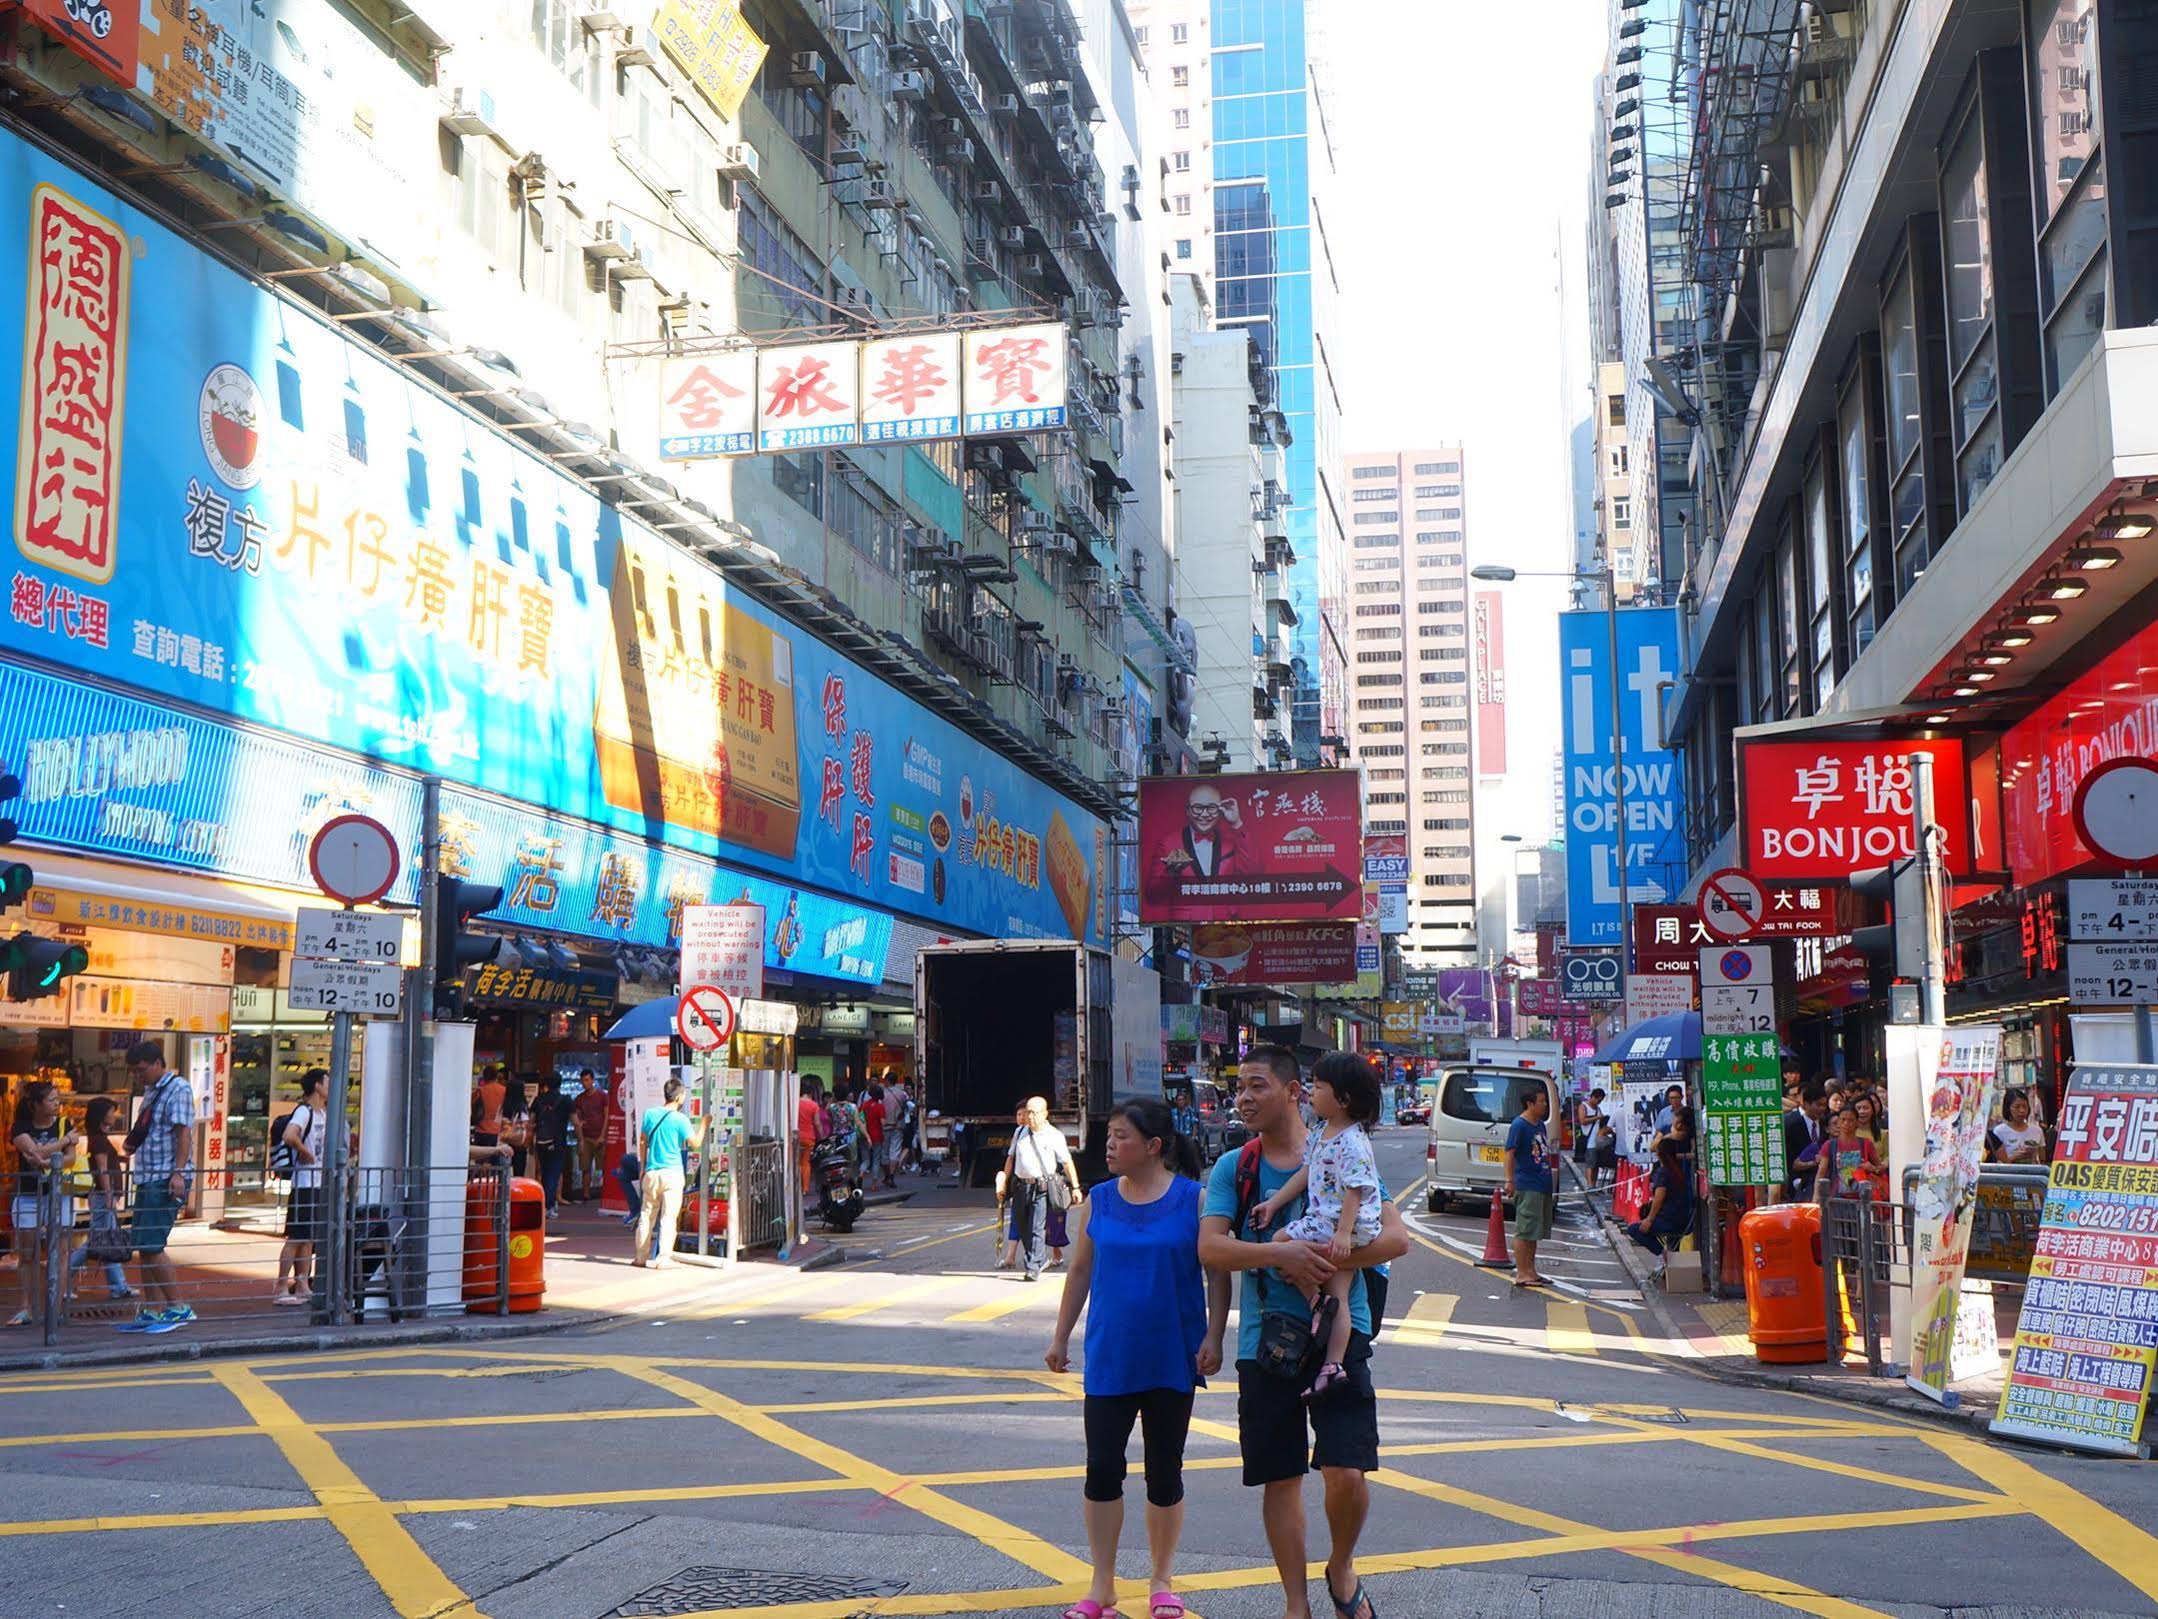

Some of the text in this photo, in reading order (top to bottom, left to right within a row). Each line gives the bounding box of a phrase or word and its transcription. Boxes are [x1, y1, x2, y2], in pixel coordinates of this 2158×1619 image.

[11, 571, 109, 648] 總代理
[28, 727, 191, 805] HOLLYWOOD
[1573, 763, 1673, 798] NOW
[102, 802, 174, 845] SHOPPING
[1573, 801, 1673, 832] OPEN
[1367, 860, 1406, 872] EASY
[331, 912, 372, 922] Saturdays
[708, 910, 740, 918] Vehicle
[2081, 912, 2097, 920] pm
[692, 920, 724, 928] waiting
[728, 920, 743, 928] will
[1654, 917, 1750, 945] 周大
[1776, 920, 1822, 931] TAI FOOK
[698, 931, 749, 939] prosecuted
[376, 940, 396, 957] 10
[686, 940, 721, 948] without
[2096, 946, 2137, 955] General
[313, 962, 343, 971] General
[1655, 960, 1690, 972] CHOW
[2075, 976, 2101, 984] noon
[375, 993, 395, 1008] 10
[1638, 993, 1681, 1001] prosecuted
[1747, 989, 1759, 1004] 7
[1706, 1014, 1771, 1031] midnight 12
[1706, 1038, 1778, 1062] 高價收購
[1708, 1116, 1726, 1183] 專業相機
[1727, 1116, 1745, 1183] 手提電腦
[1748, 1116, 1765, 1182] 手提電話
[2079, 1202, 2128, 1229] 8202
